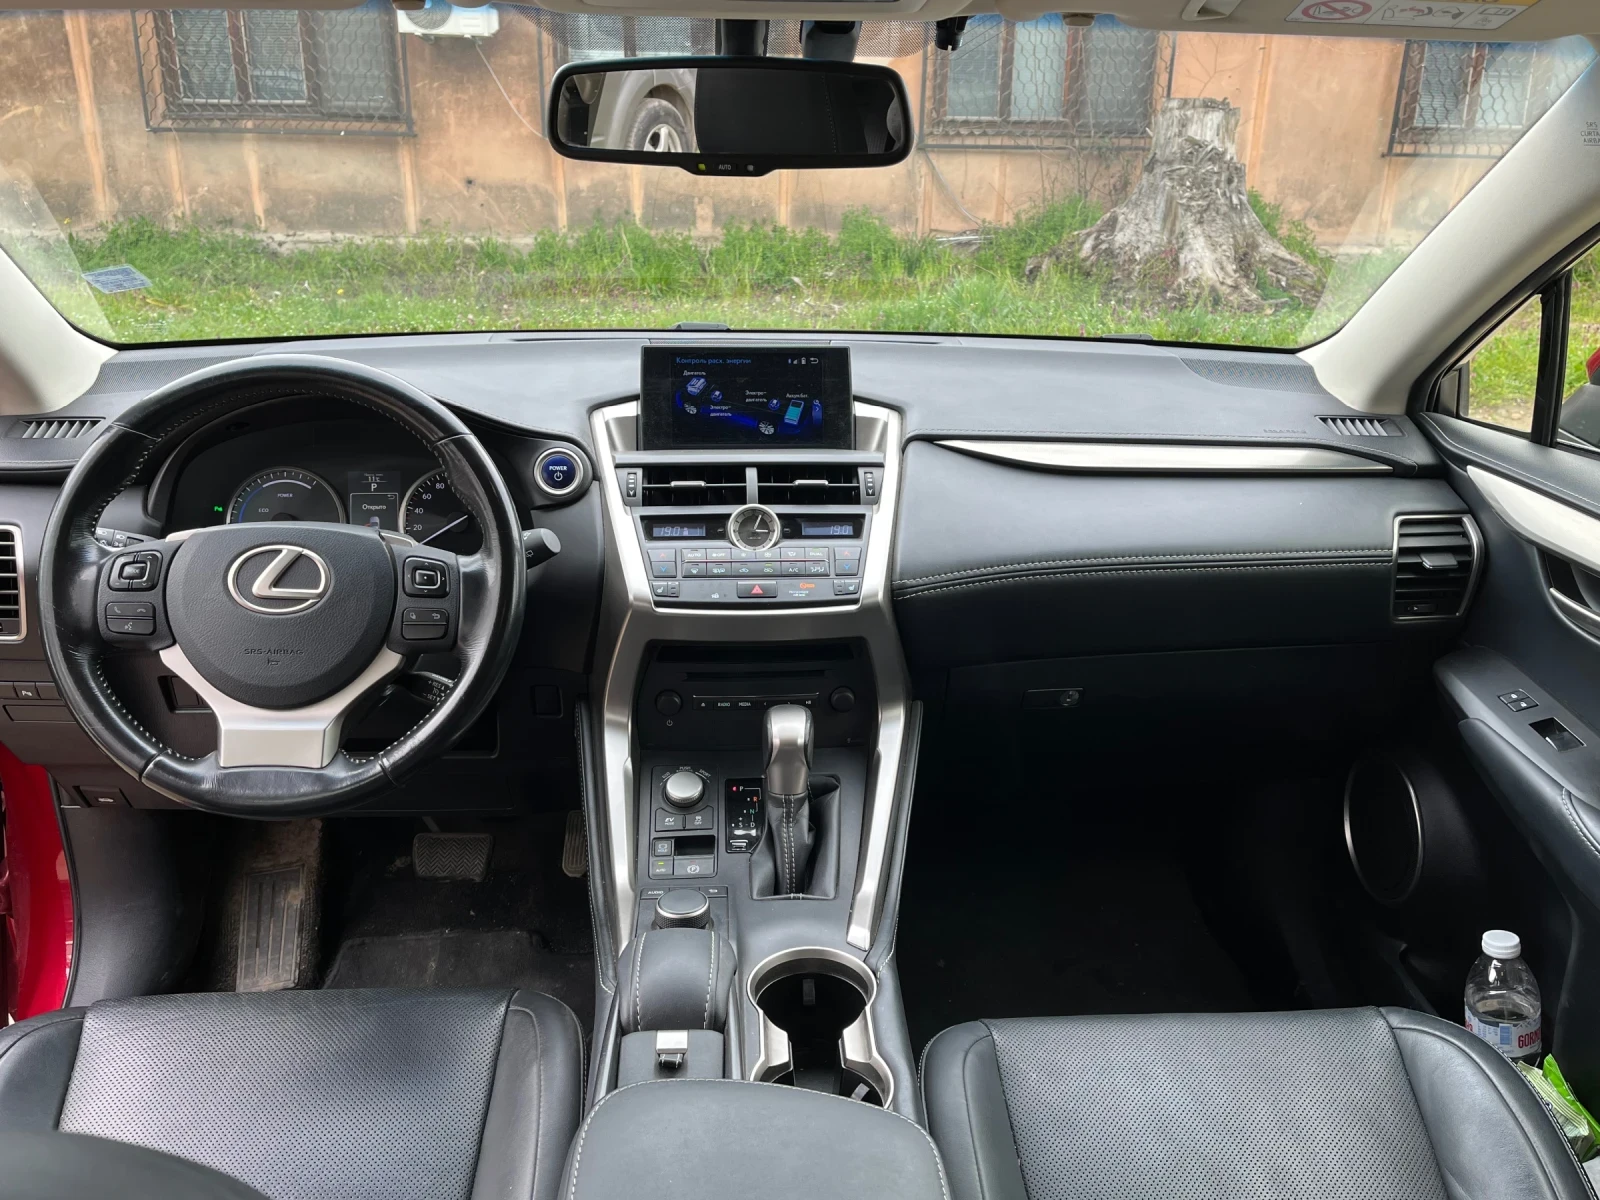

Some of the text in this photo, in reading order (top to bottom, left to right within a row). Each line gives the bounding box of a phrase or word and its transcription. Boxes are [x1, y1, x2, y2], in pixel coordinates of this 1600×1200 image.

[676, 356, 707, 365] Контроль
[371, 483, 378, 492] P
[435, 482, 445, 490] 80
[362, 503, 387, 511] Открыто
[698, 768, 712, 778] SPORT
